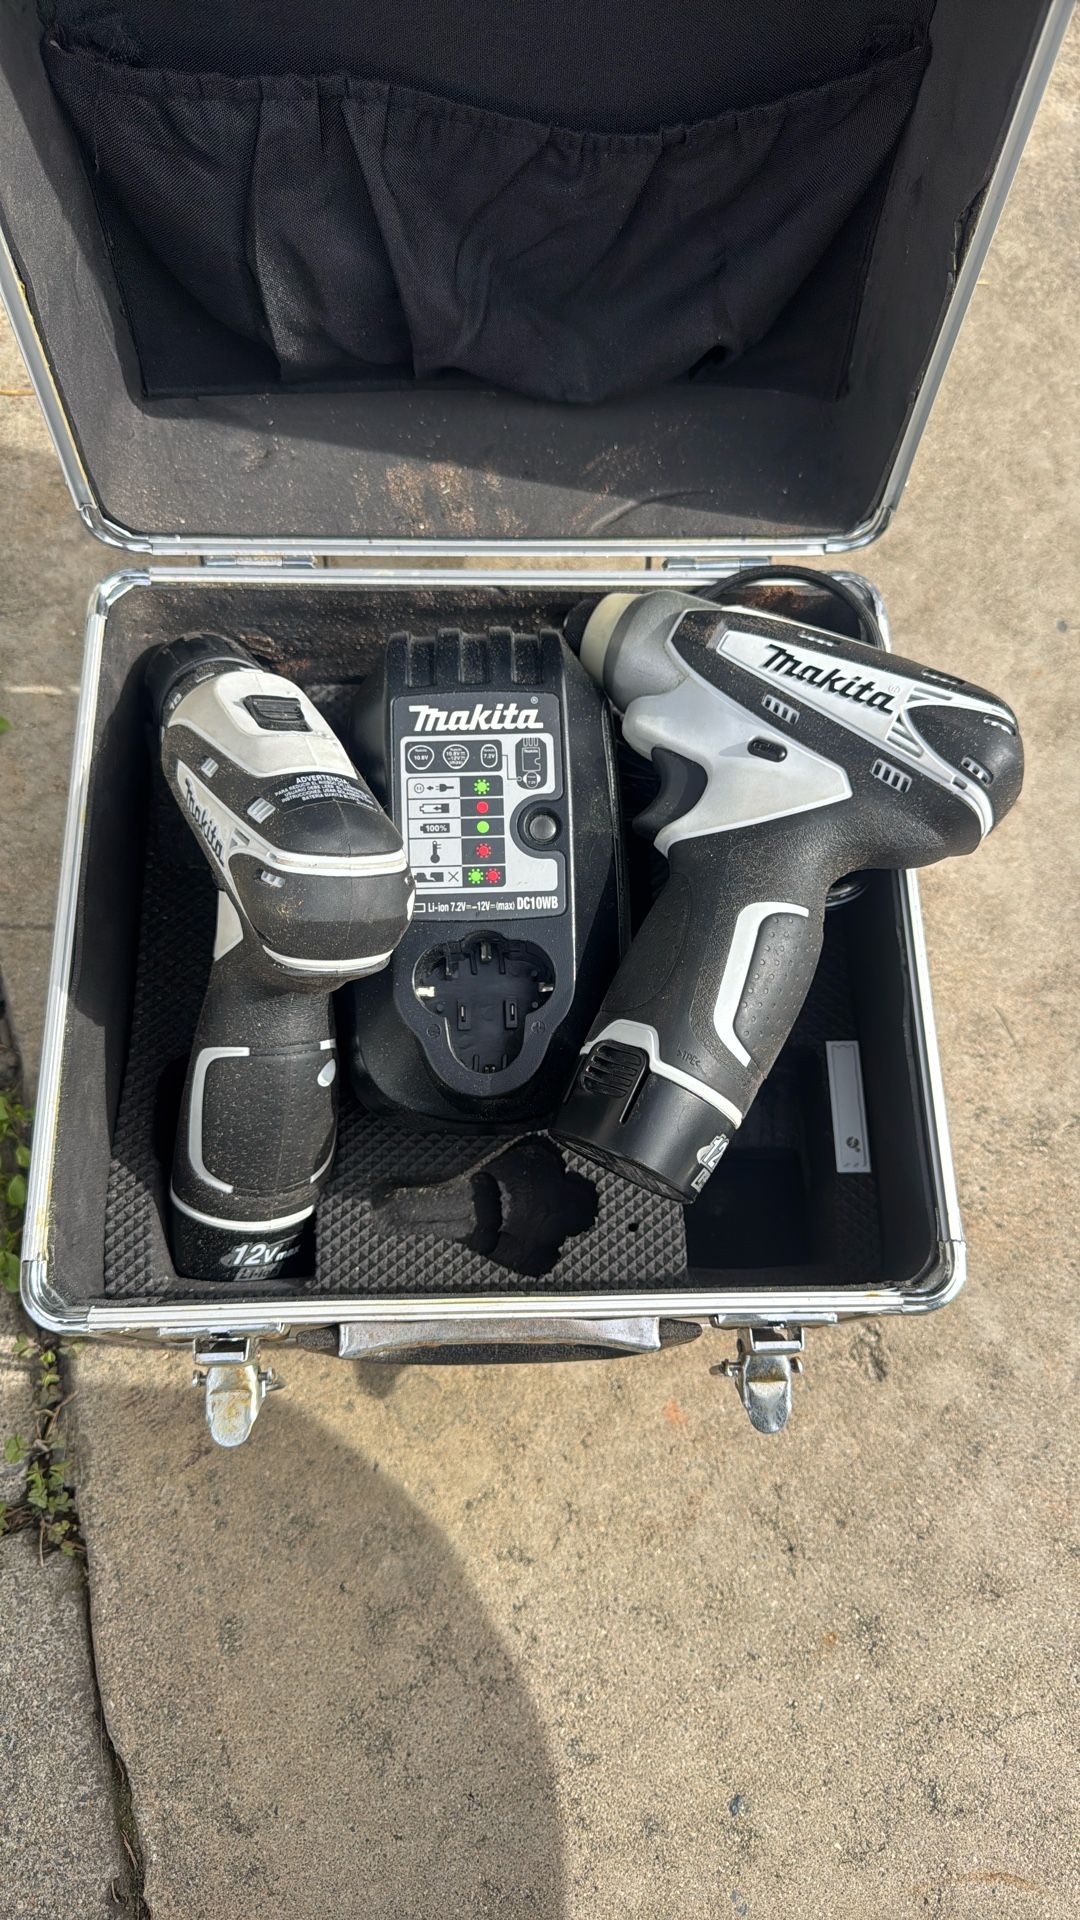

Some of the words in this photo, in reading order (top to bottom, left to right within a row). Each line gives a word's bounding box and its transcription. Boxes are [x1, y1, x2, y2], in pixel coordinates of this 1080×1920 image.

[763, 644, 895, 714] Makita
[409, 703, 544, 732] Makita
[185, 777, 224, 867] Makita
[425, 824, 447, 832] 100%
[516, 896, 559, 910] DC10WB
